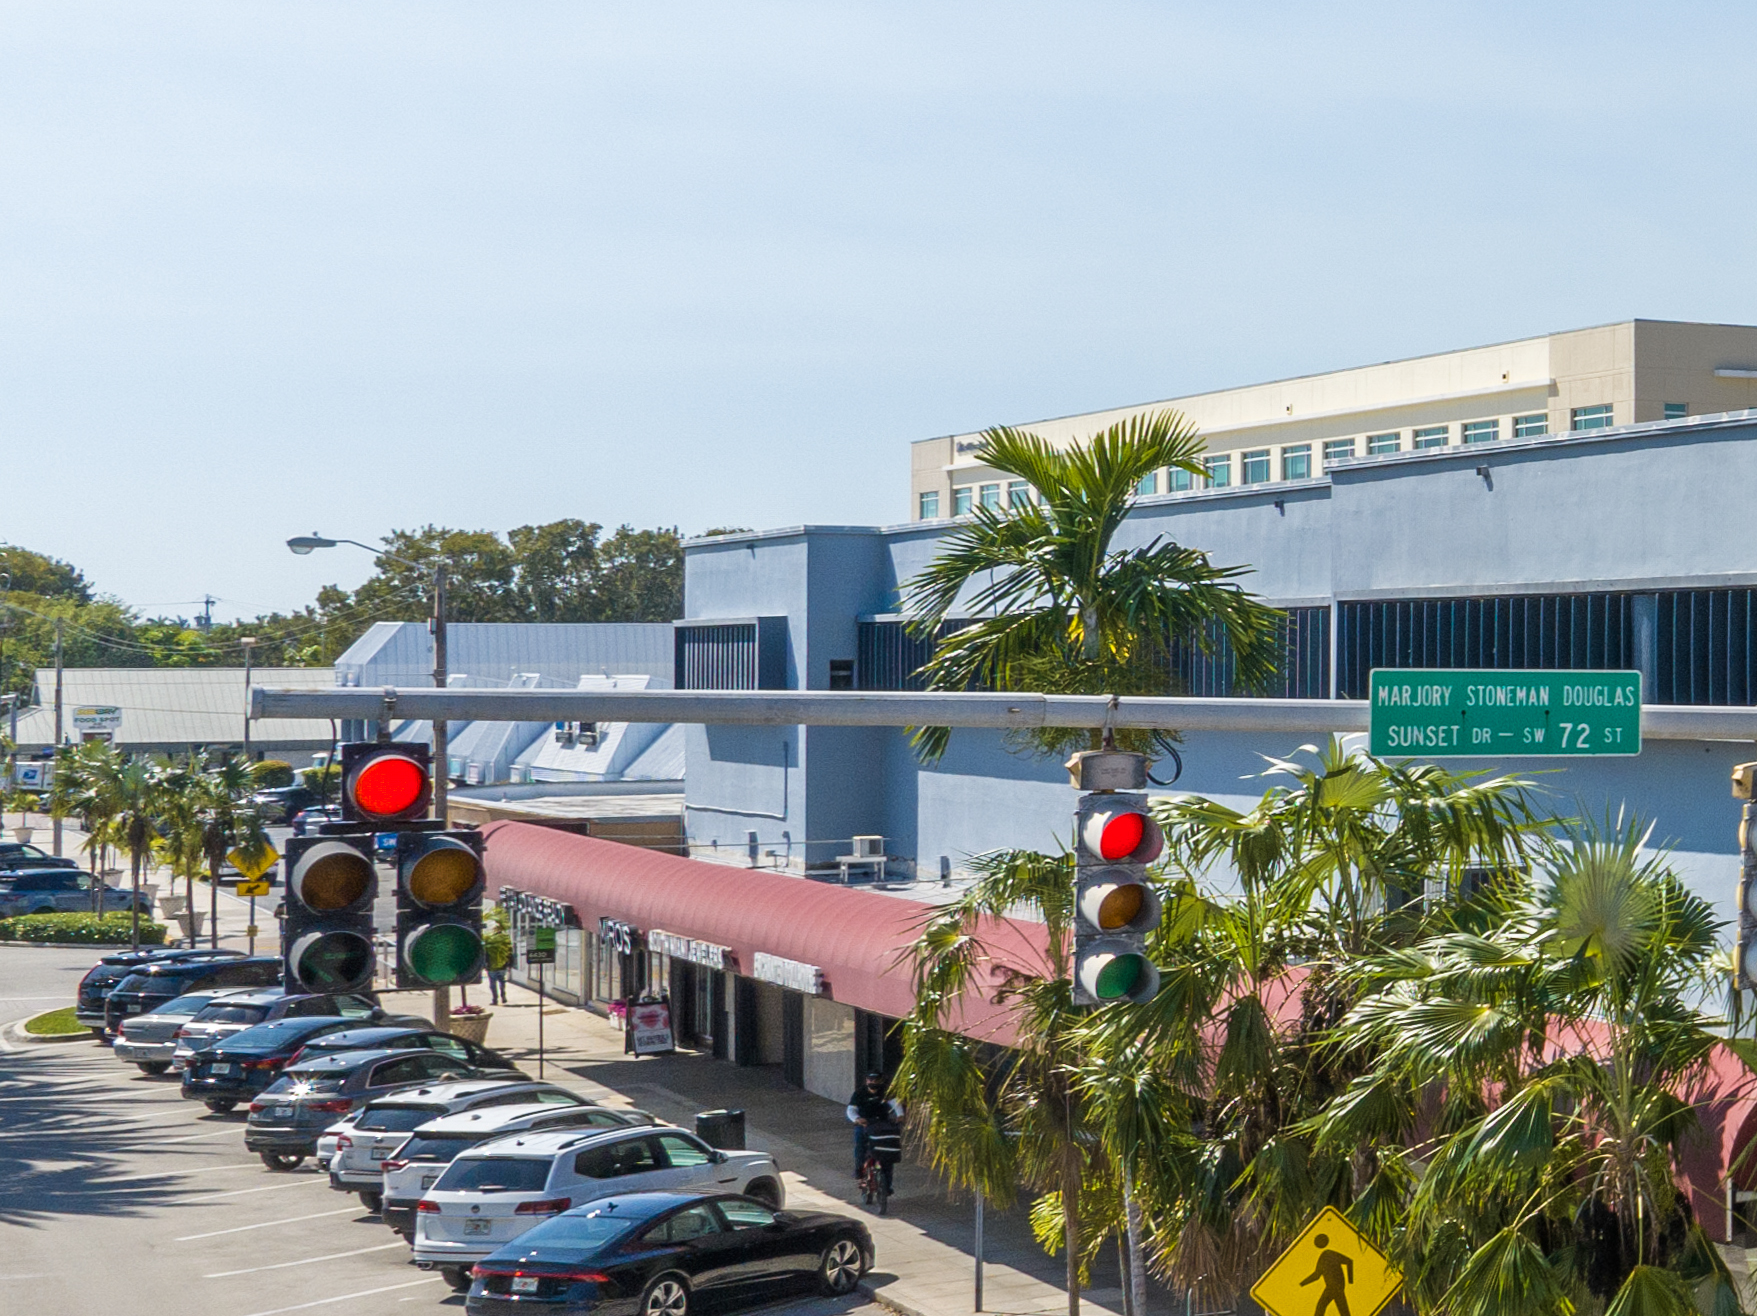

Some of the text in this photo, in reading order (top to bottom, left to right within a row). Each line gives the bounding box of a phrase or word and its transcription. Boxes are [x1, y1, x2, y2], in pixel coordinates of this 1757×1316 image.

[1378, 685, 1635, 706] MARJORY STONEMAN DOUGLAS
[1387, 725, 1460, 747] SUNSET
[1472, 728, 1491, 744] DR
[1523, 727, 1545, 743] SW
[1559, 723, 1591, 748] 72
[1604, 728, 1622, 743] ST
